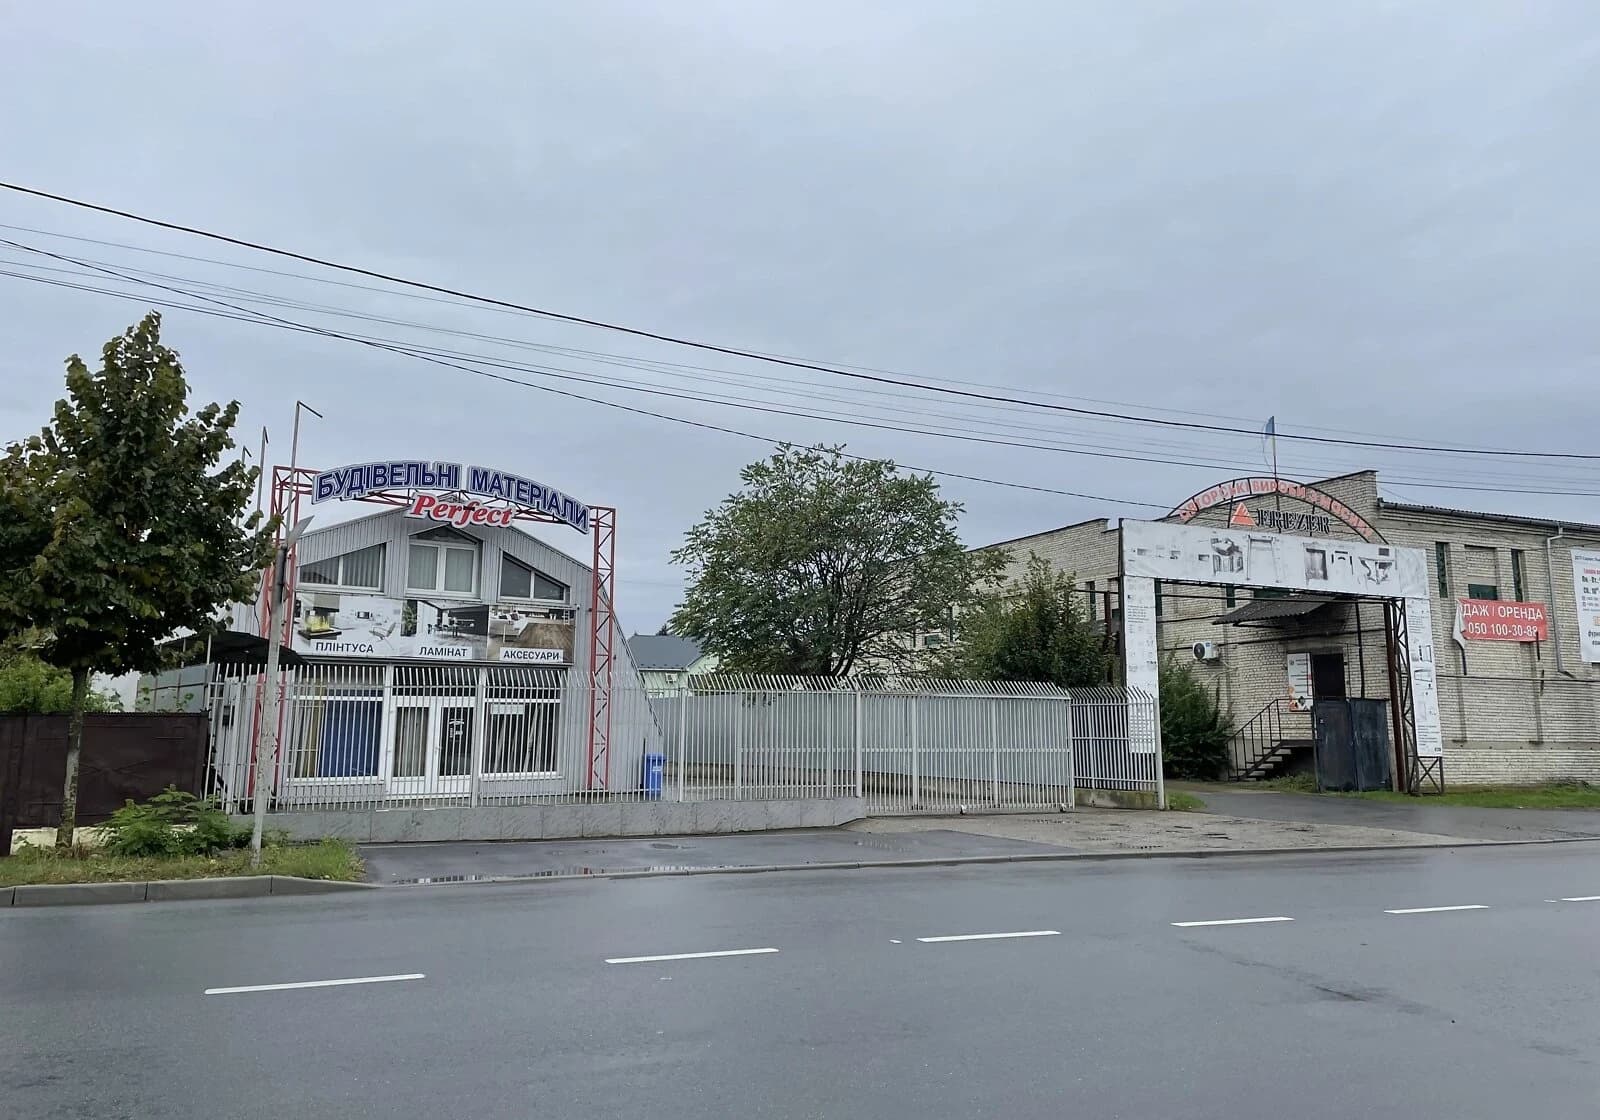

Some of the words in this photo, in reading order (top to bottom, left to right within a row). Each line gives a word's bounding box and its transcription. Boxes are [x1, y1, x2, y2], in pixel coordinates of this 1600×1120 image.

[316, 462, 460, 499] БУДІВЕЛЬНІ
[470, 467, 589, 530] МАТЕРІАЛИ
[410, 495, 513, 526] Perfect
[1460, 603, 1489, 617] ДАЖ
[1498, 606, 1543, 620] ОРЕНДА
[1468, 622, 1487, 634] 050
[315, 642, 374, 653] ПЛІНТУСА
[419, 646, 467, 657] ЛАМІНАТ
[503, 650, 560, 661] АКСЕСУАРИ
